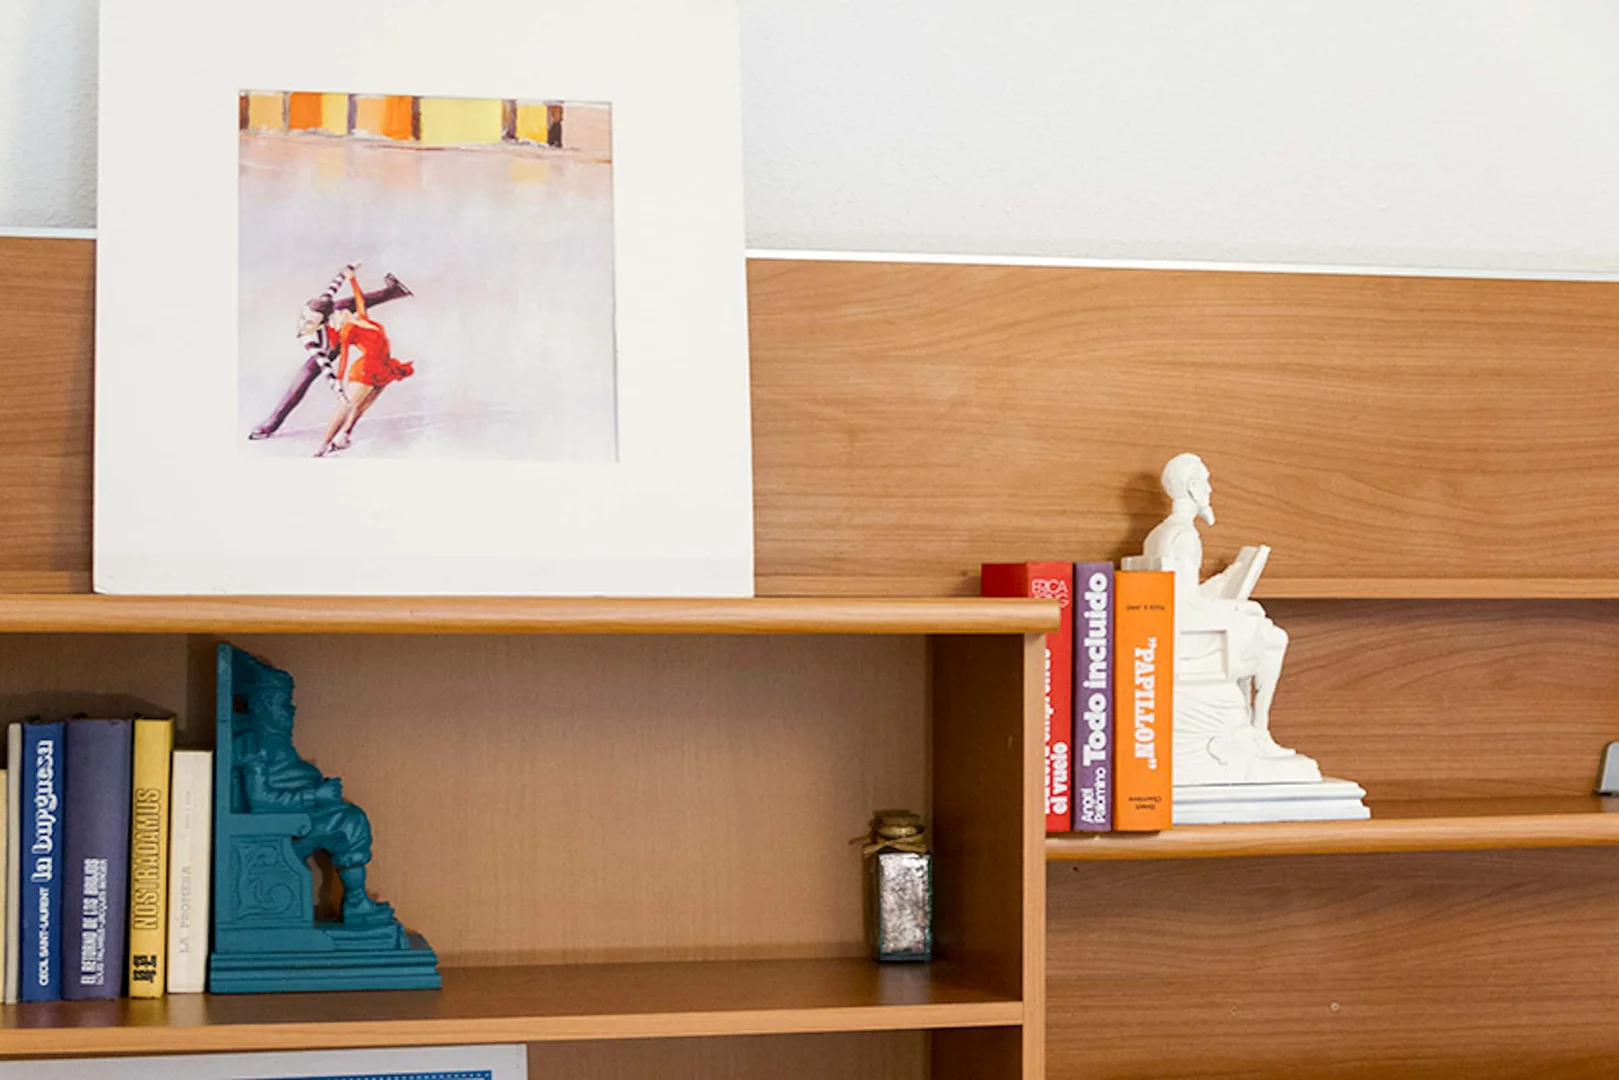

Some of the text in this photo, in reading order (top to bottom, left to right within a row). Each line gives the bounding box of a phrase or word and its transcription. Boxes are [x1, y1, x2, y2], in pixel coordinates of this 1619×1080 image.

[1083, 572, 1108, 766] Todo incluido
[30, 740, 59, 883] la burguesa
[1051, 742, 1068, 814] el vuelo
[132, 787, 161, 930] NOSTRADAMUS
